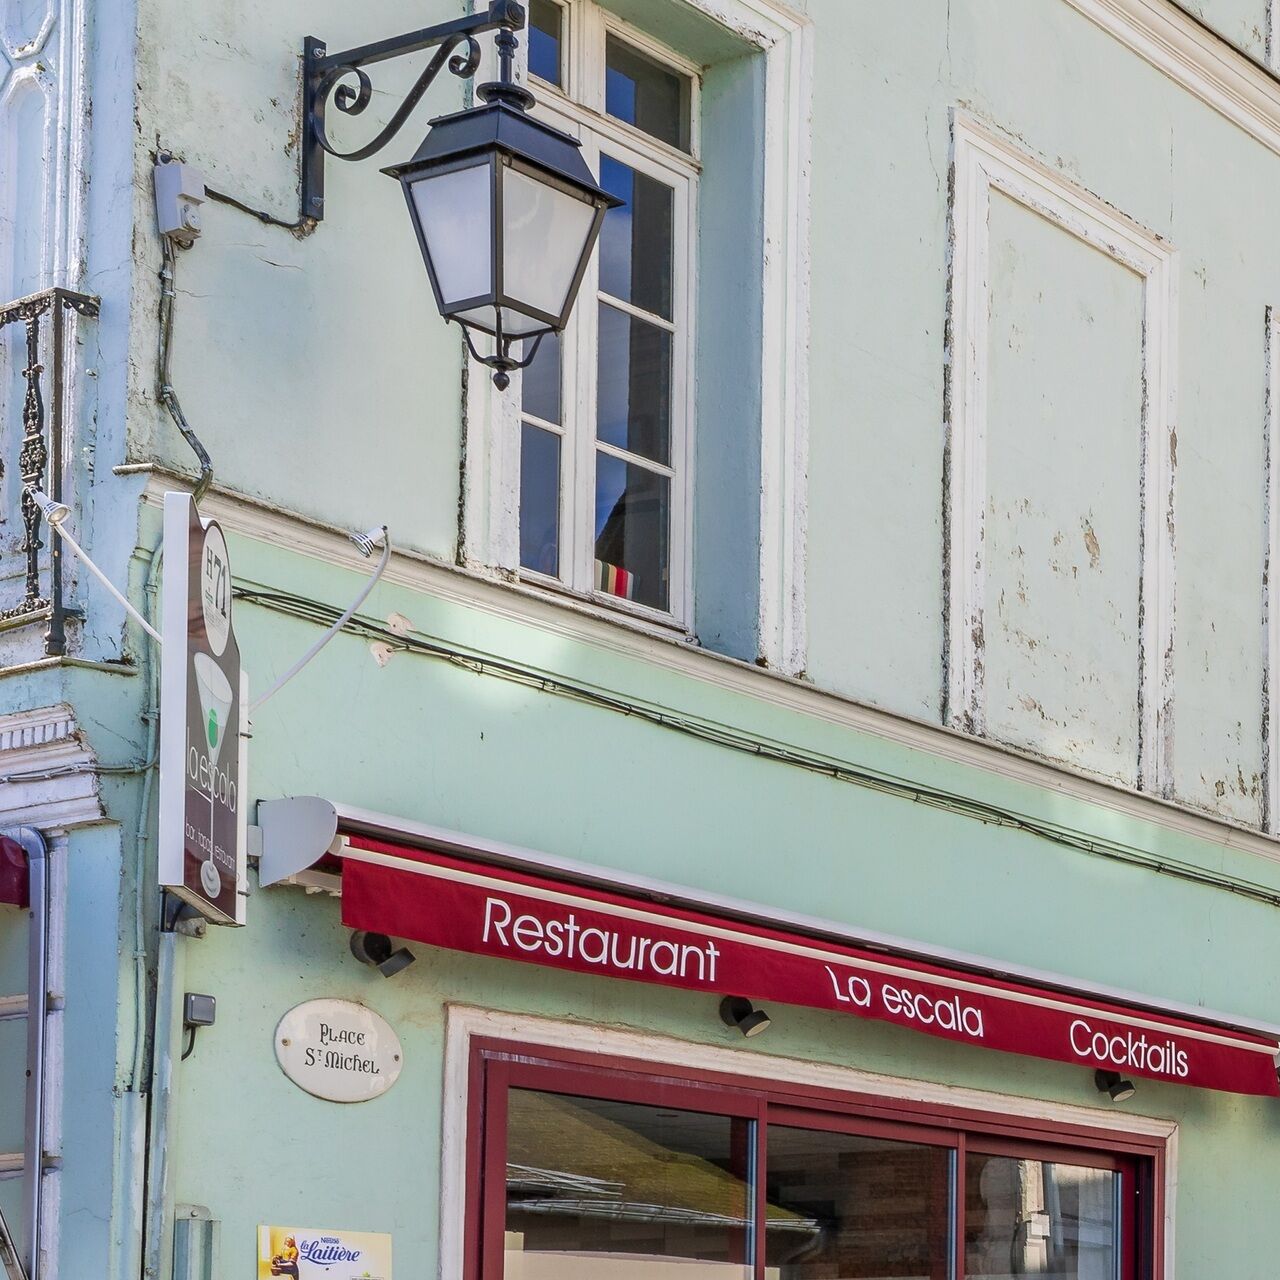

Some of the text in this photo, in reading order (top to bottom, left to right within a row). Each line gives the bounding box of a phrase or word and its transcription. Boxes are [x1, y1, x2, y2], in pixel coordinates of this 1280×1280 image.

[187, 726, 236, 814] la escala
[482, 897, 721, 982] Restaurant
[825, 965, 985, 1038] La escala
[1069, 1019, 1189, 1079] Cocktails
[301, 1241, 360, 1265] Laitière
